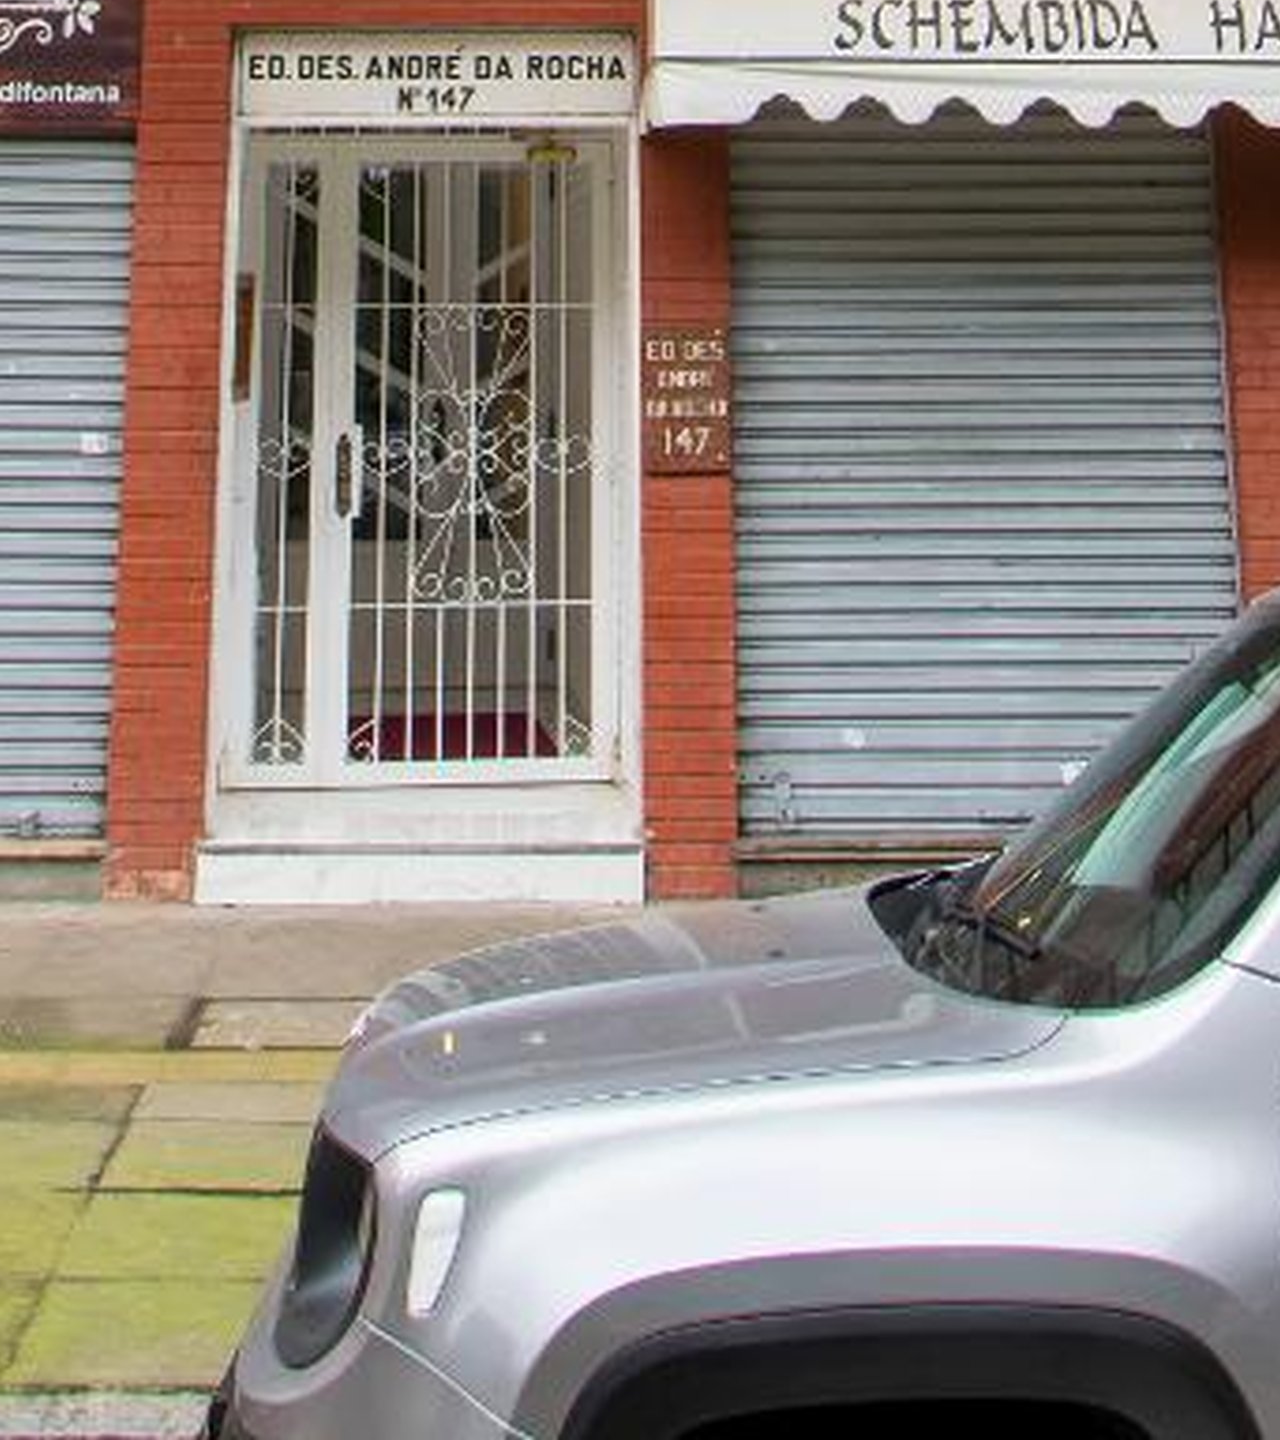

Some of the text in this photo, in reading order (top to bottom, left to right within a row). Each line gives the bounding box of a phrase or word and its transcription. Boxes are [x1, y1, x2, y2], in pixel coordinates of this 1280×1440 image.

[474, 55, 514, 80] DA
[526, 55, 626, 80] ROCHA
[426, 85, 476, 113] 147
[663, 427, 712, 456] 147
